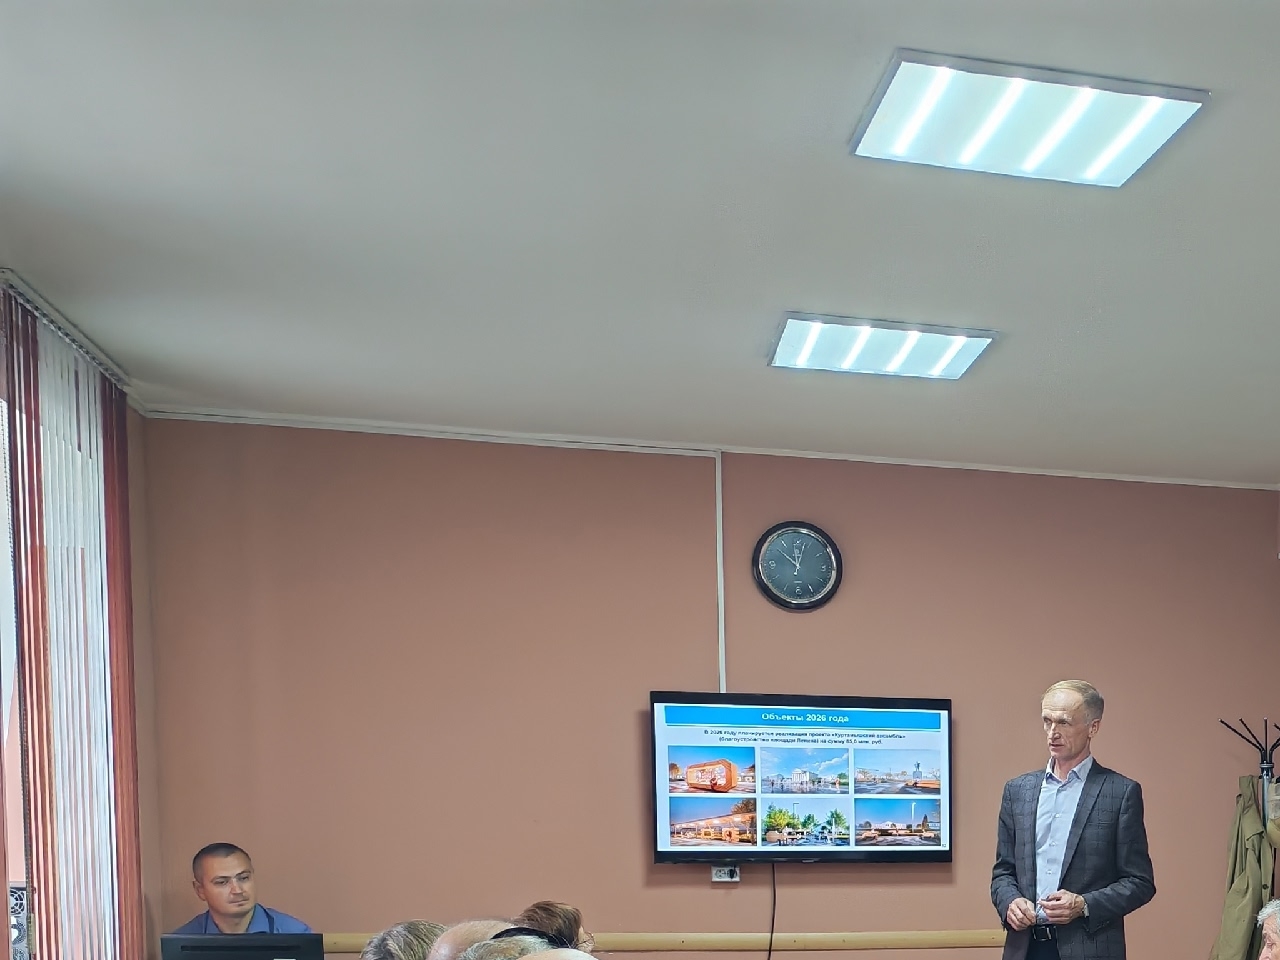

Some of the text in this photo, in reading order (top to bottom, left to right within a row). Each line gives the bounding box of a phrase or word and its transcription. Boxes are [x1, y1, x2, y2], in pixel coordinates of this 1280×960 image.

[761, 713, 849, 723] Объекты 2026 года
